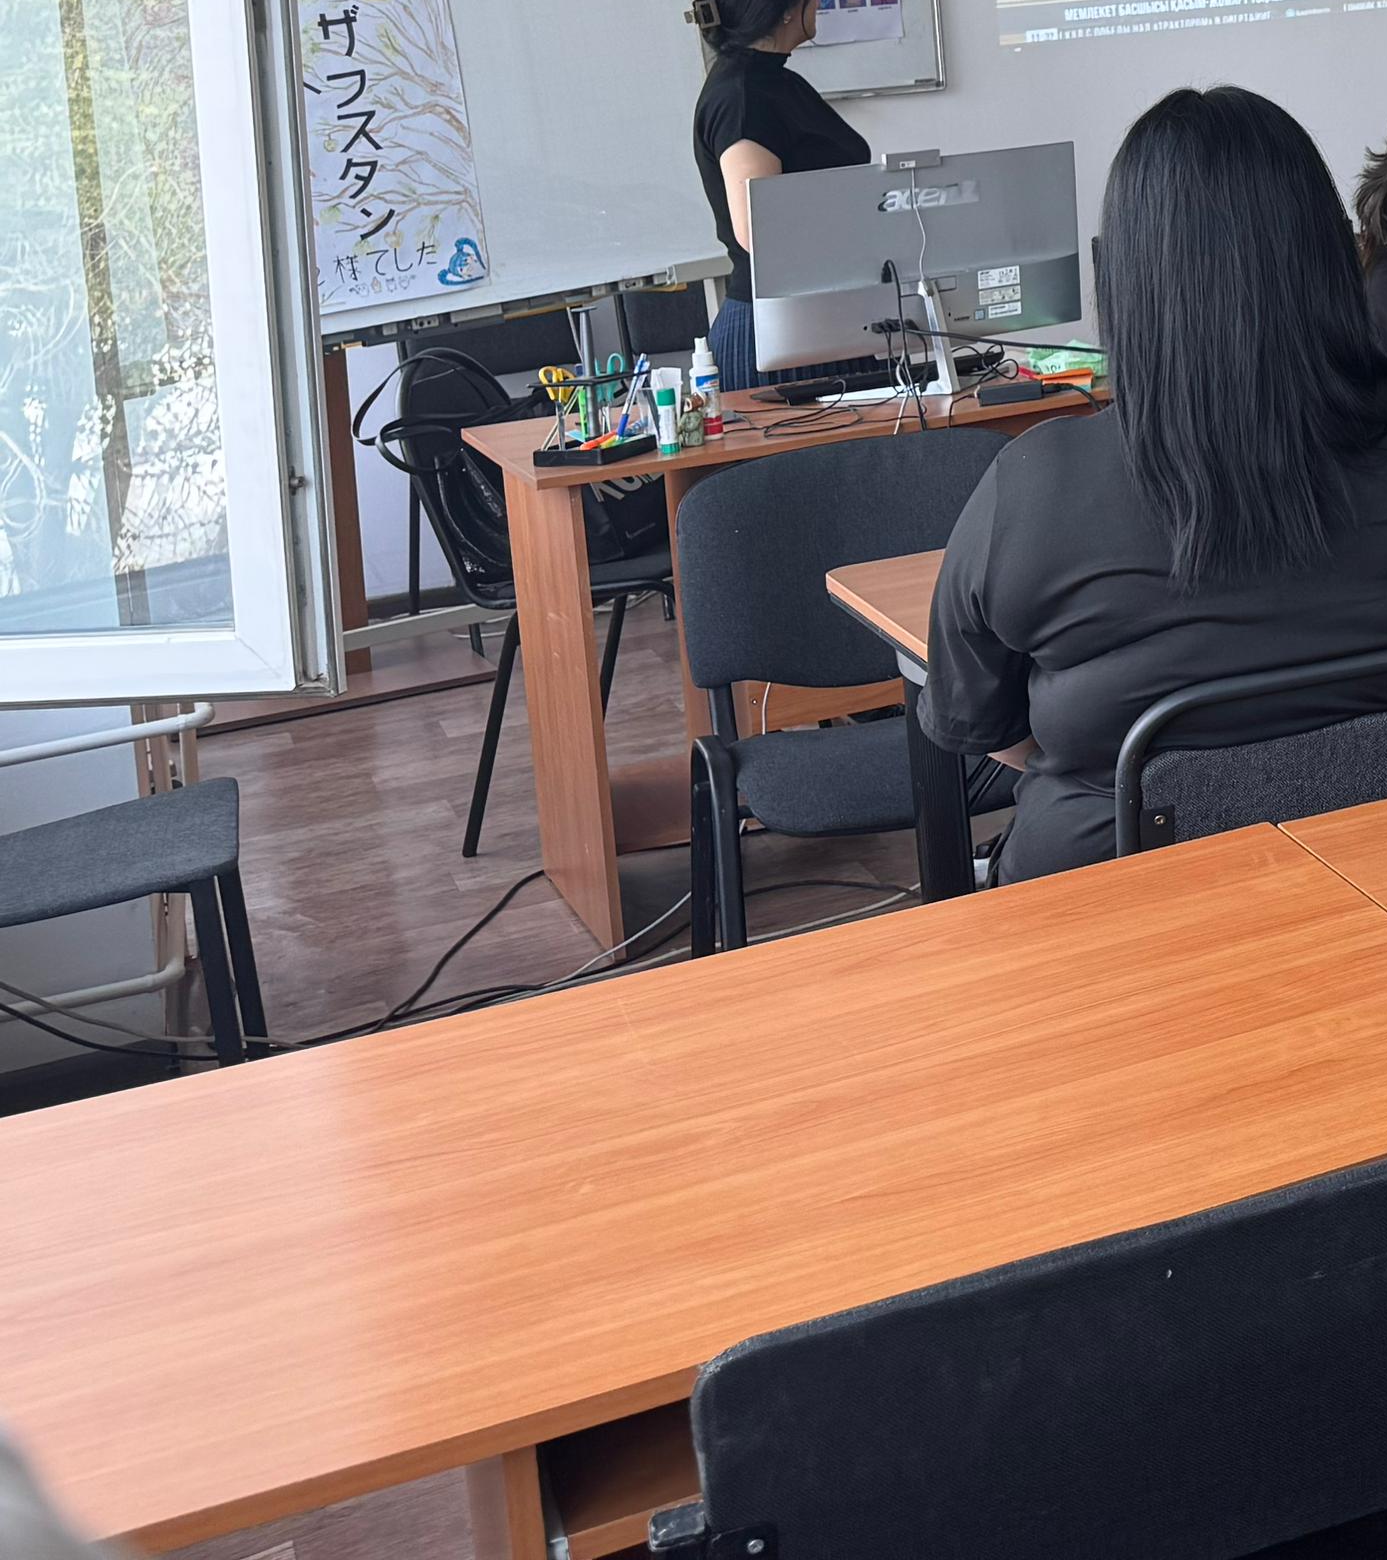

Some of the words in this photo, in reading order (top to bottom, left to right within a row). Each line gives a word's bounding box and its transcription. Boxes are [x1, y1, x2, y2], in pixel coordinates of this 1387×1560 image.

[1064, 4, 1117, 21] МЕМЛЕКЕТ
[1118, 0, 1169, 17] БАСШЫСЫ
[877, 183, 959, 212] acer
